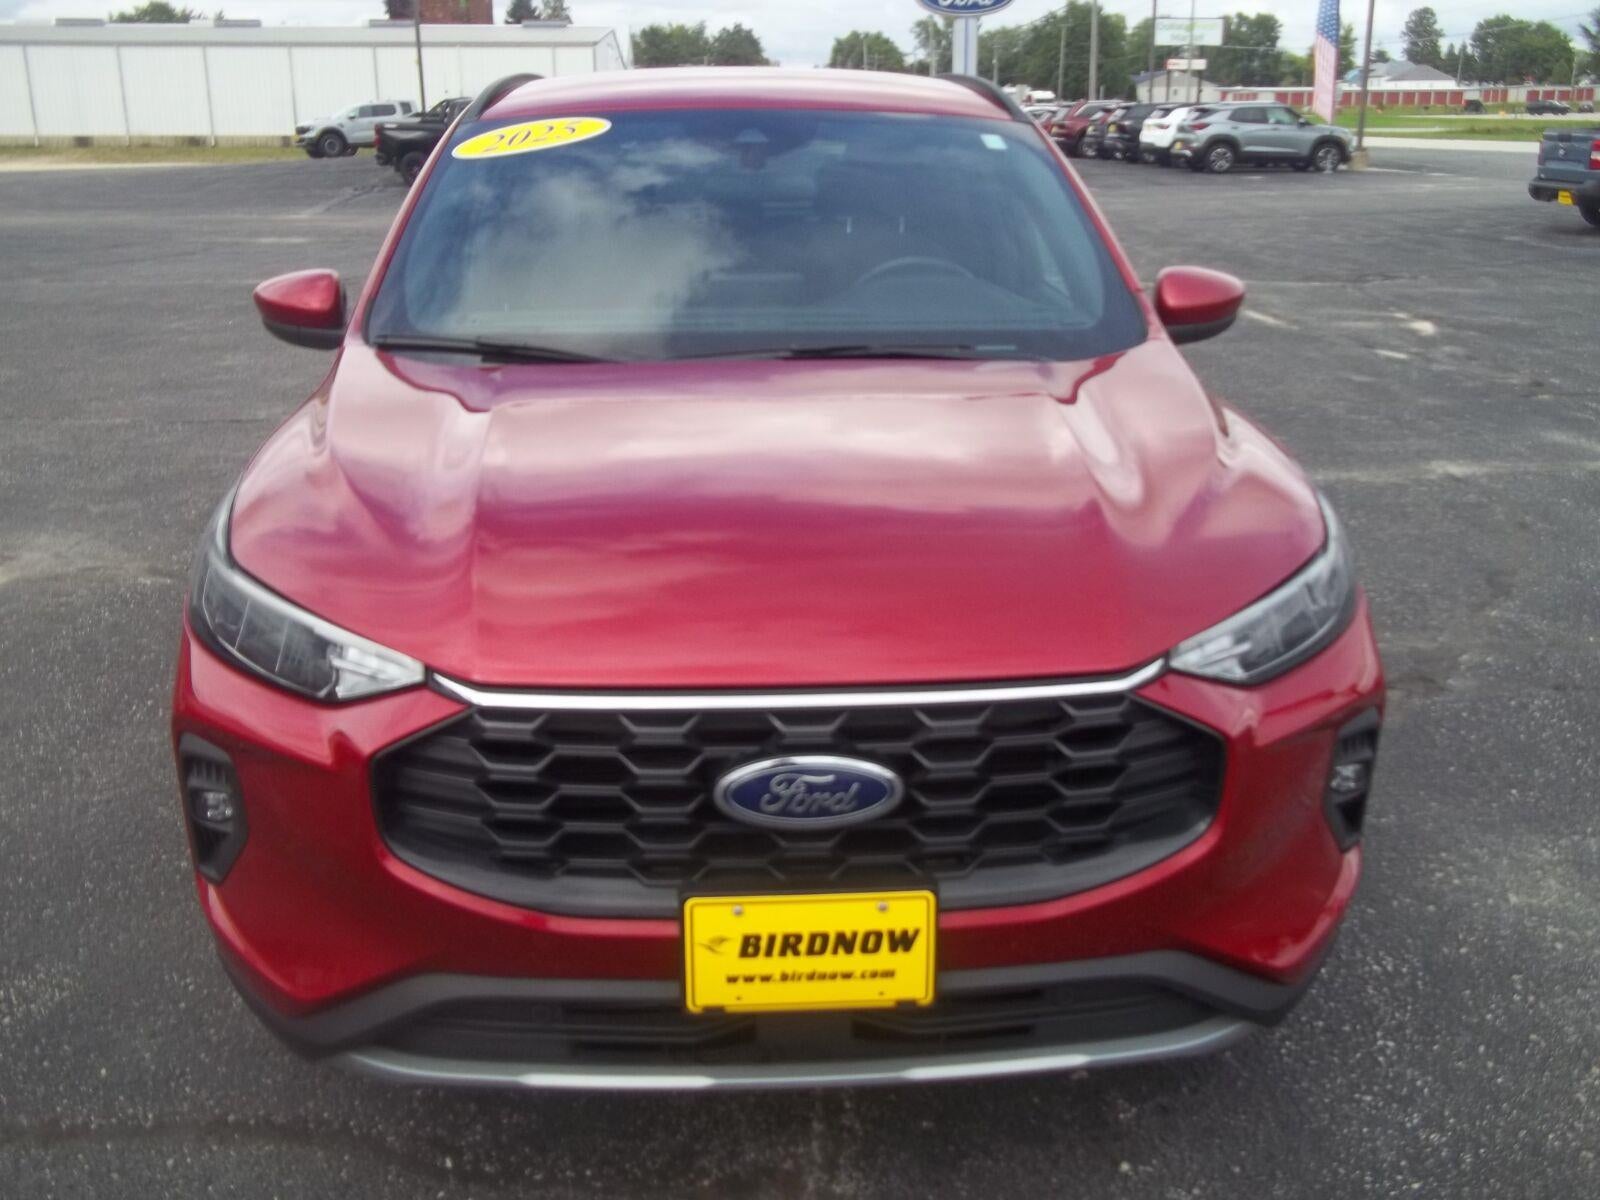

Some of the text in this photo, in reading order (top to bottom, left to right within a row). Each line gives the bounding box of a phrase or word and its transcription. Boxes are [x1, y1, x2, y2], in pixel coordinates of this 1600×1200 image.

[484, 120, 583, 153] 2025
[760, 773, 860, 813] Ford
[739, 927, 921, 959] BIRDNOW
[725, 968, 897, 984] www.birdnow.com
